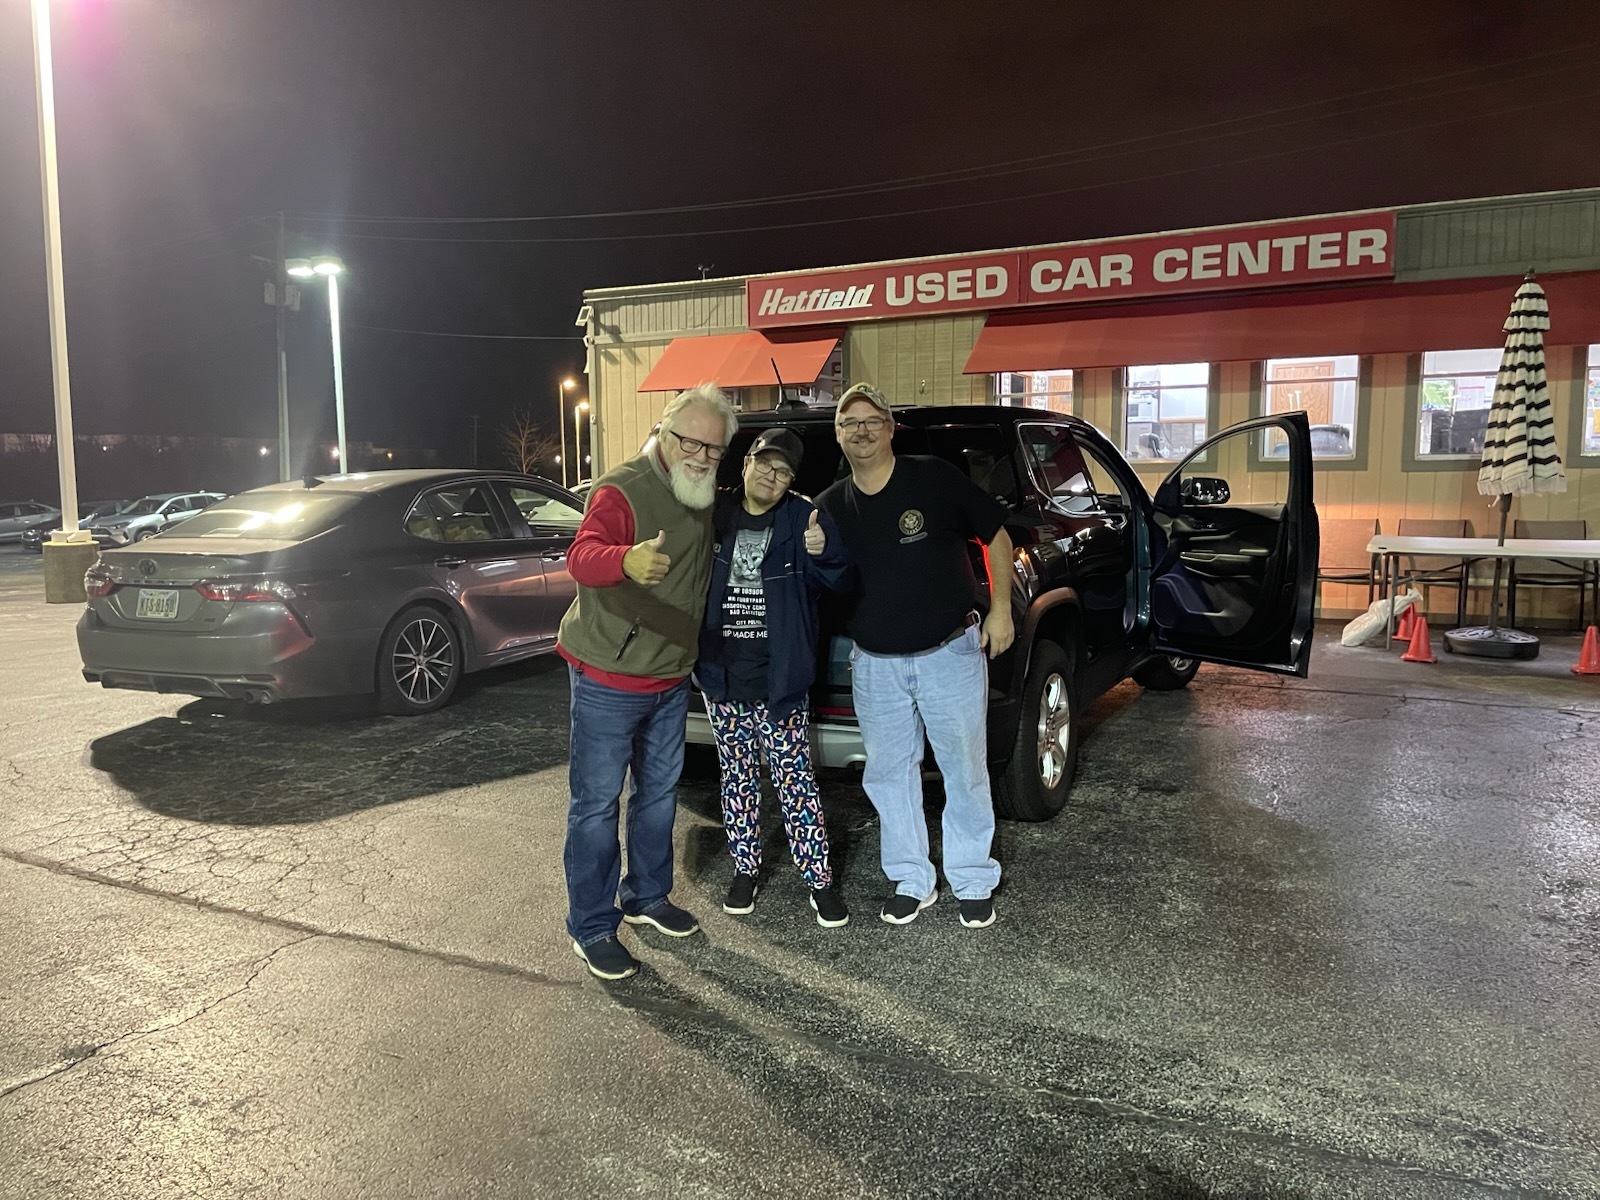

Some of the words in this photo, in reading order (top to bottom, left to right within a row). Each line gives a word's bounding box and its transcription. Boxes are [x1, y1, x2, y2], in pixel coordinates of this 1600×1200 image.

[757, 283, 874, 317] Hatfield
[885, 265, 1009, 307] USED
[1029, 253, 1133, 294] CAR
[1152, 228, 1389, 283] CENTER
[756, 630, 768, 639] ME
